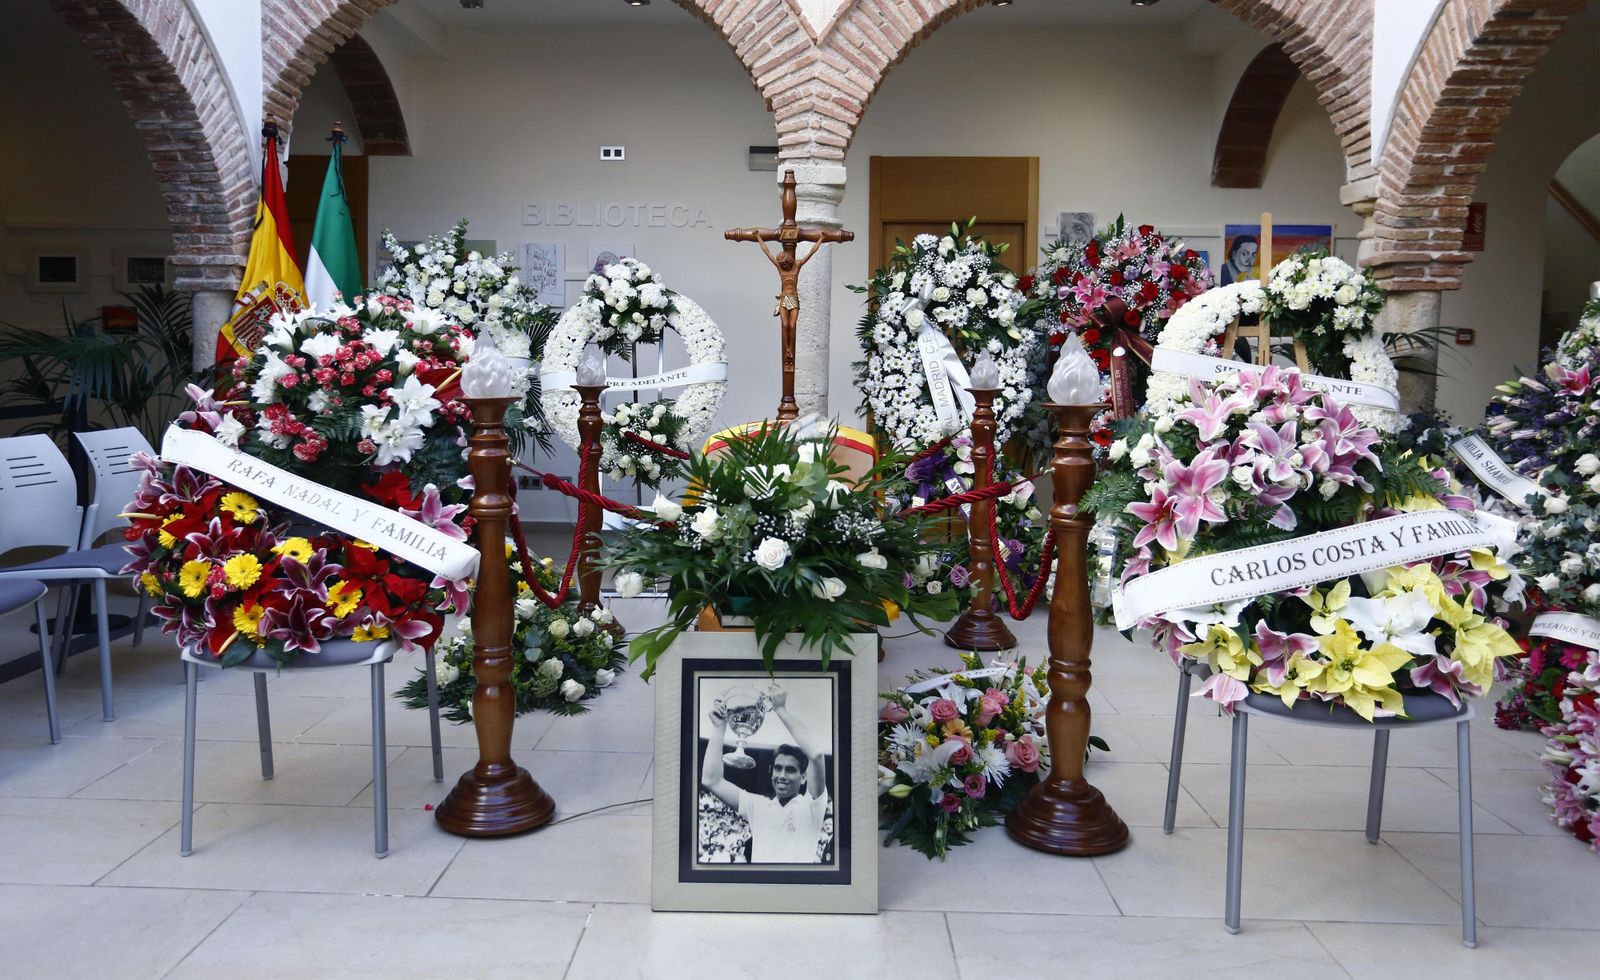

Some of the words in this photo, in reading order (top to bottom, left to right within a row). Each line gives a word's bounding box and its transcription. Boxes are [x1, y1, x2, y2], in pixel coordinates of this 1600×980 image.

[522, 201, 713, 229] BIBLIOTECA
[630, 371, 689, 387] ADELANTE
[929, 360, 951, 408] MADRID
[1114, 369, 1121, 378] EN
[1115, 381, 1123, 406] SIEMPRE
[226, 459, 276, 488] RAFA
[282, 484, 342, 515] NADAL
[352, 508, 369, 522] Y
[370, 516, 447, 561] FAMILIA
[1210, 552, 1307, 587] CARLOS
[1312, 535, 1387, 567] COSTA
[1390, 525, 1405, 549] Y
[1411, 519, 1486, 544] FAMILIA
[1581, 628, 1591, 637] Y
